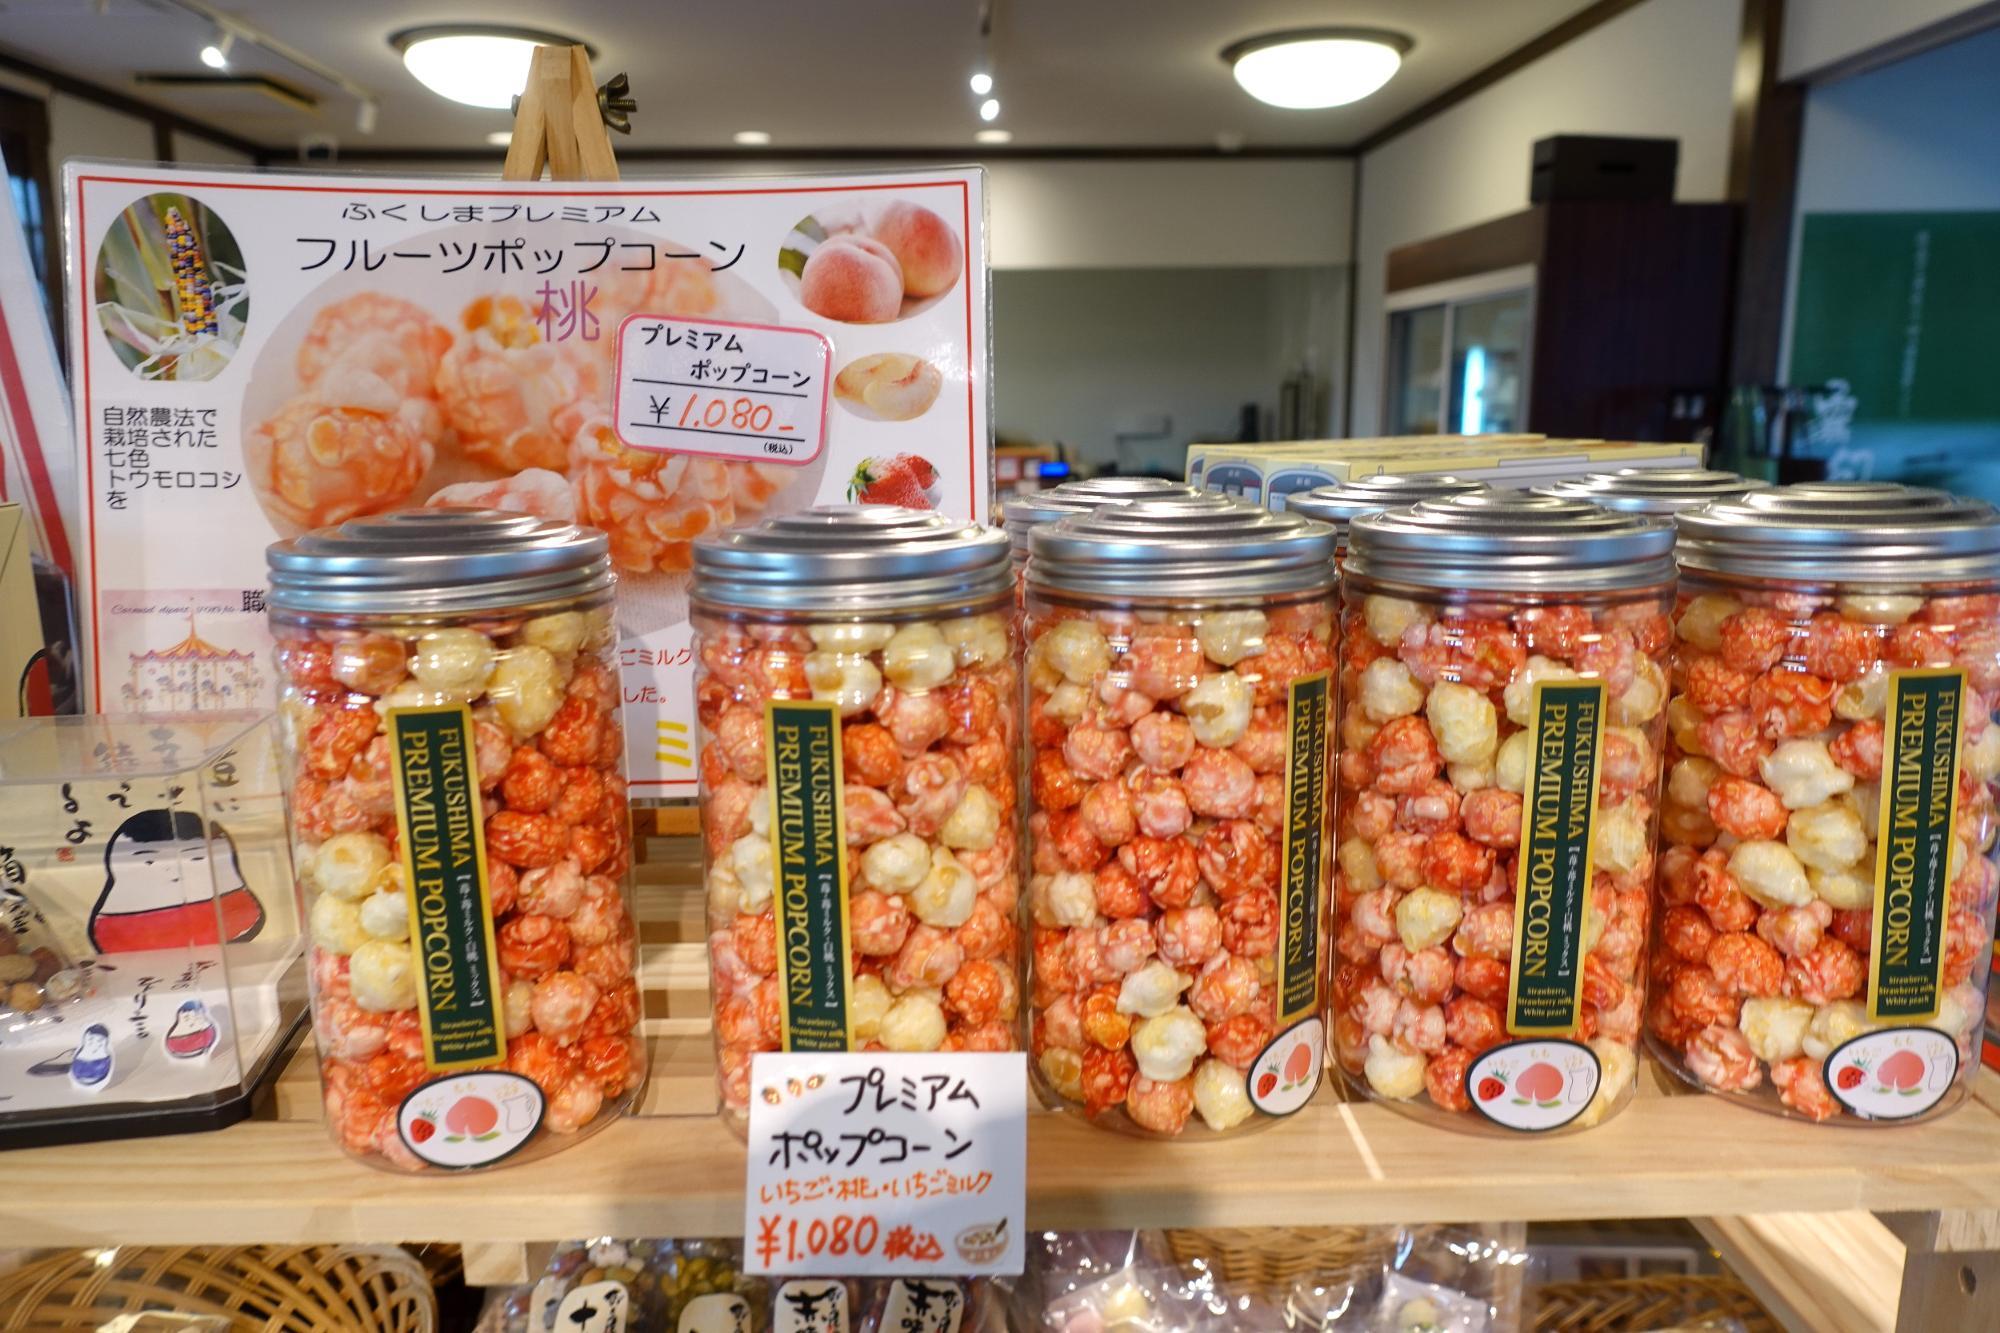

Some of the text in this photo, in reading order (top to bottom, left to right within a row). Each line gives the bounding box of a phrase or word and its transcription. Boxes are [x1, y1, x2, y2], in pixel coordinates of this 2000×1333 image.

[342, 202, 661, 224] ふくしまプレミアム
[296, 237, 746, 275] フルーツポップコーン
[535, 280, 600, 343] 桃
[641, 324, 744, 353] プレミアム
[690, 359, 811, 388] ポップコーン
[104, 405, 217, 427] 自然農法で
[104, 427, 219, 448] 栽培された
[104, 448, 150, 468] 七色
[109, 469, 242, 489] トウモロコシ
[106, 490, 128, 510] を
[624, 685, 668, 704] した。
[1311, 694, 1325, 825] FUKUSHIMA
[1568, 703, 1594, 840] FUKUSHIMA
[1929, 691, 1955, 828] FUKUSHIMA
[439, 728, 472, 868] FUKUSHIMA
[809, 726, 833, 866] FUKUSHIMA
[1288, 698, 1311, 965] PREMIUM POPCORN
[1523, 703, 1567, 977] PREMIUM POPCORN
[1886, 692, 1926, 966] PREMIUM POPCORN
[403, 731, 458, 1012] PREMIUM POPCORN
[777, 726, 813, 1008] PREMIUM POPCORN
[840, 1067, 980, 1115] プレミアム
[769, 1128, 973, 1169] ポップコーン
